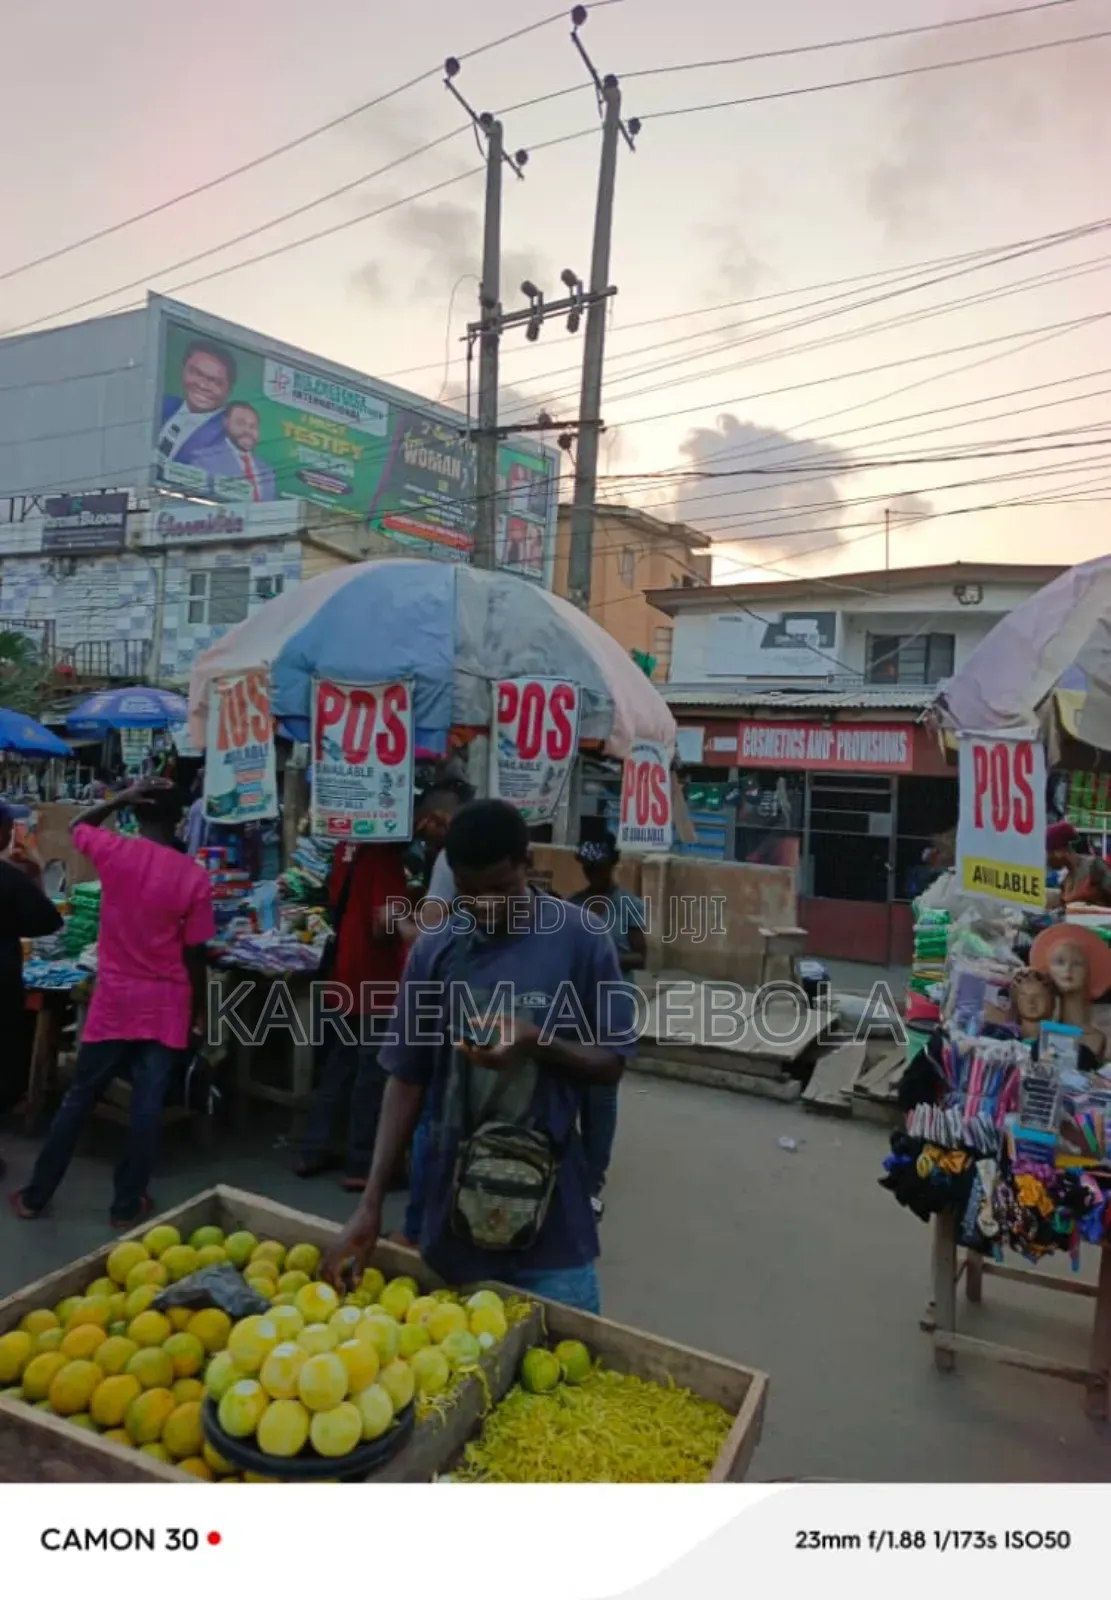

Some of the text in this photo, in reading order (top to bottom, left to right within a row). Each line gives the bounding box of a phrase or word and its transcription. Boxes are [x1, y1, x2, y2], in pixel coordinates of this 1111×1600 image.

[283, 420, 362, 459] TESTIFY
[403, 441, 461, 481] WOMAN
[314, 680, 408, 767] POS
[497, 681, 576, 761] POS
[743, 726, 907, 763] COSMETICS AND PROVISIONS
[622, 756, 670, 826] POS
[972, 740, 1035, 835] POS
